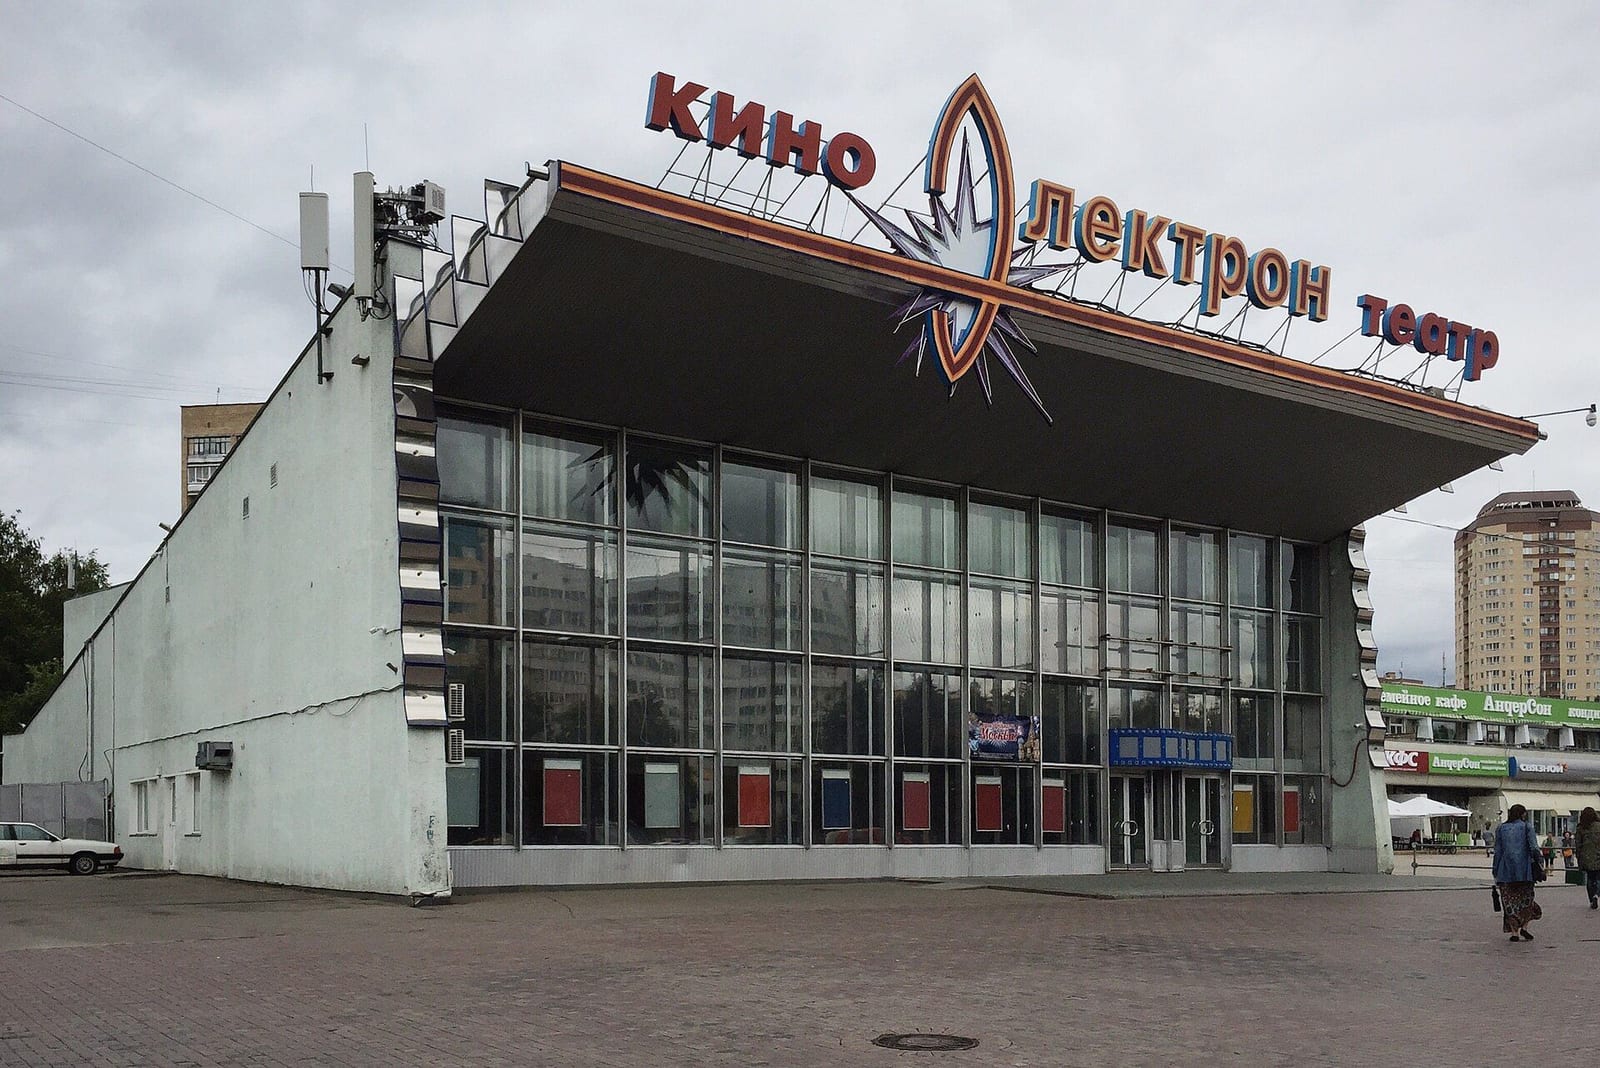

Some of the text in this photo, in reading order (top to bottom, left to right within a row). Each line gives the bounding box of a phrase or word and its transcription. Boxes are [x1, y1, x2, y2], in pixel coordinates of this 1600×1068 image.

[1357, 293, 1499, 382] театр
[1435, 694, 1467, 712] кафе
[1482, 695, 1553, 718] АндерСон
